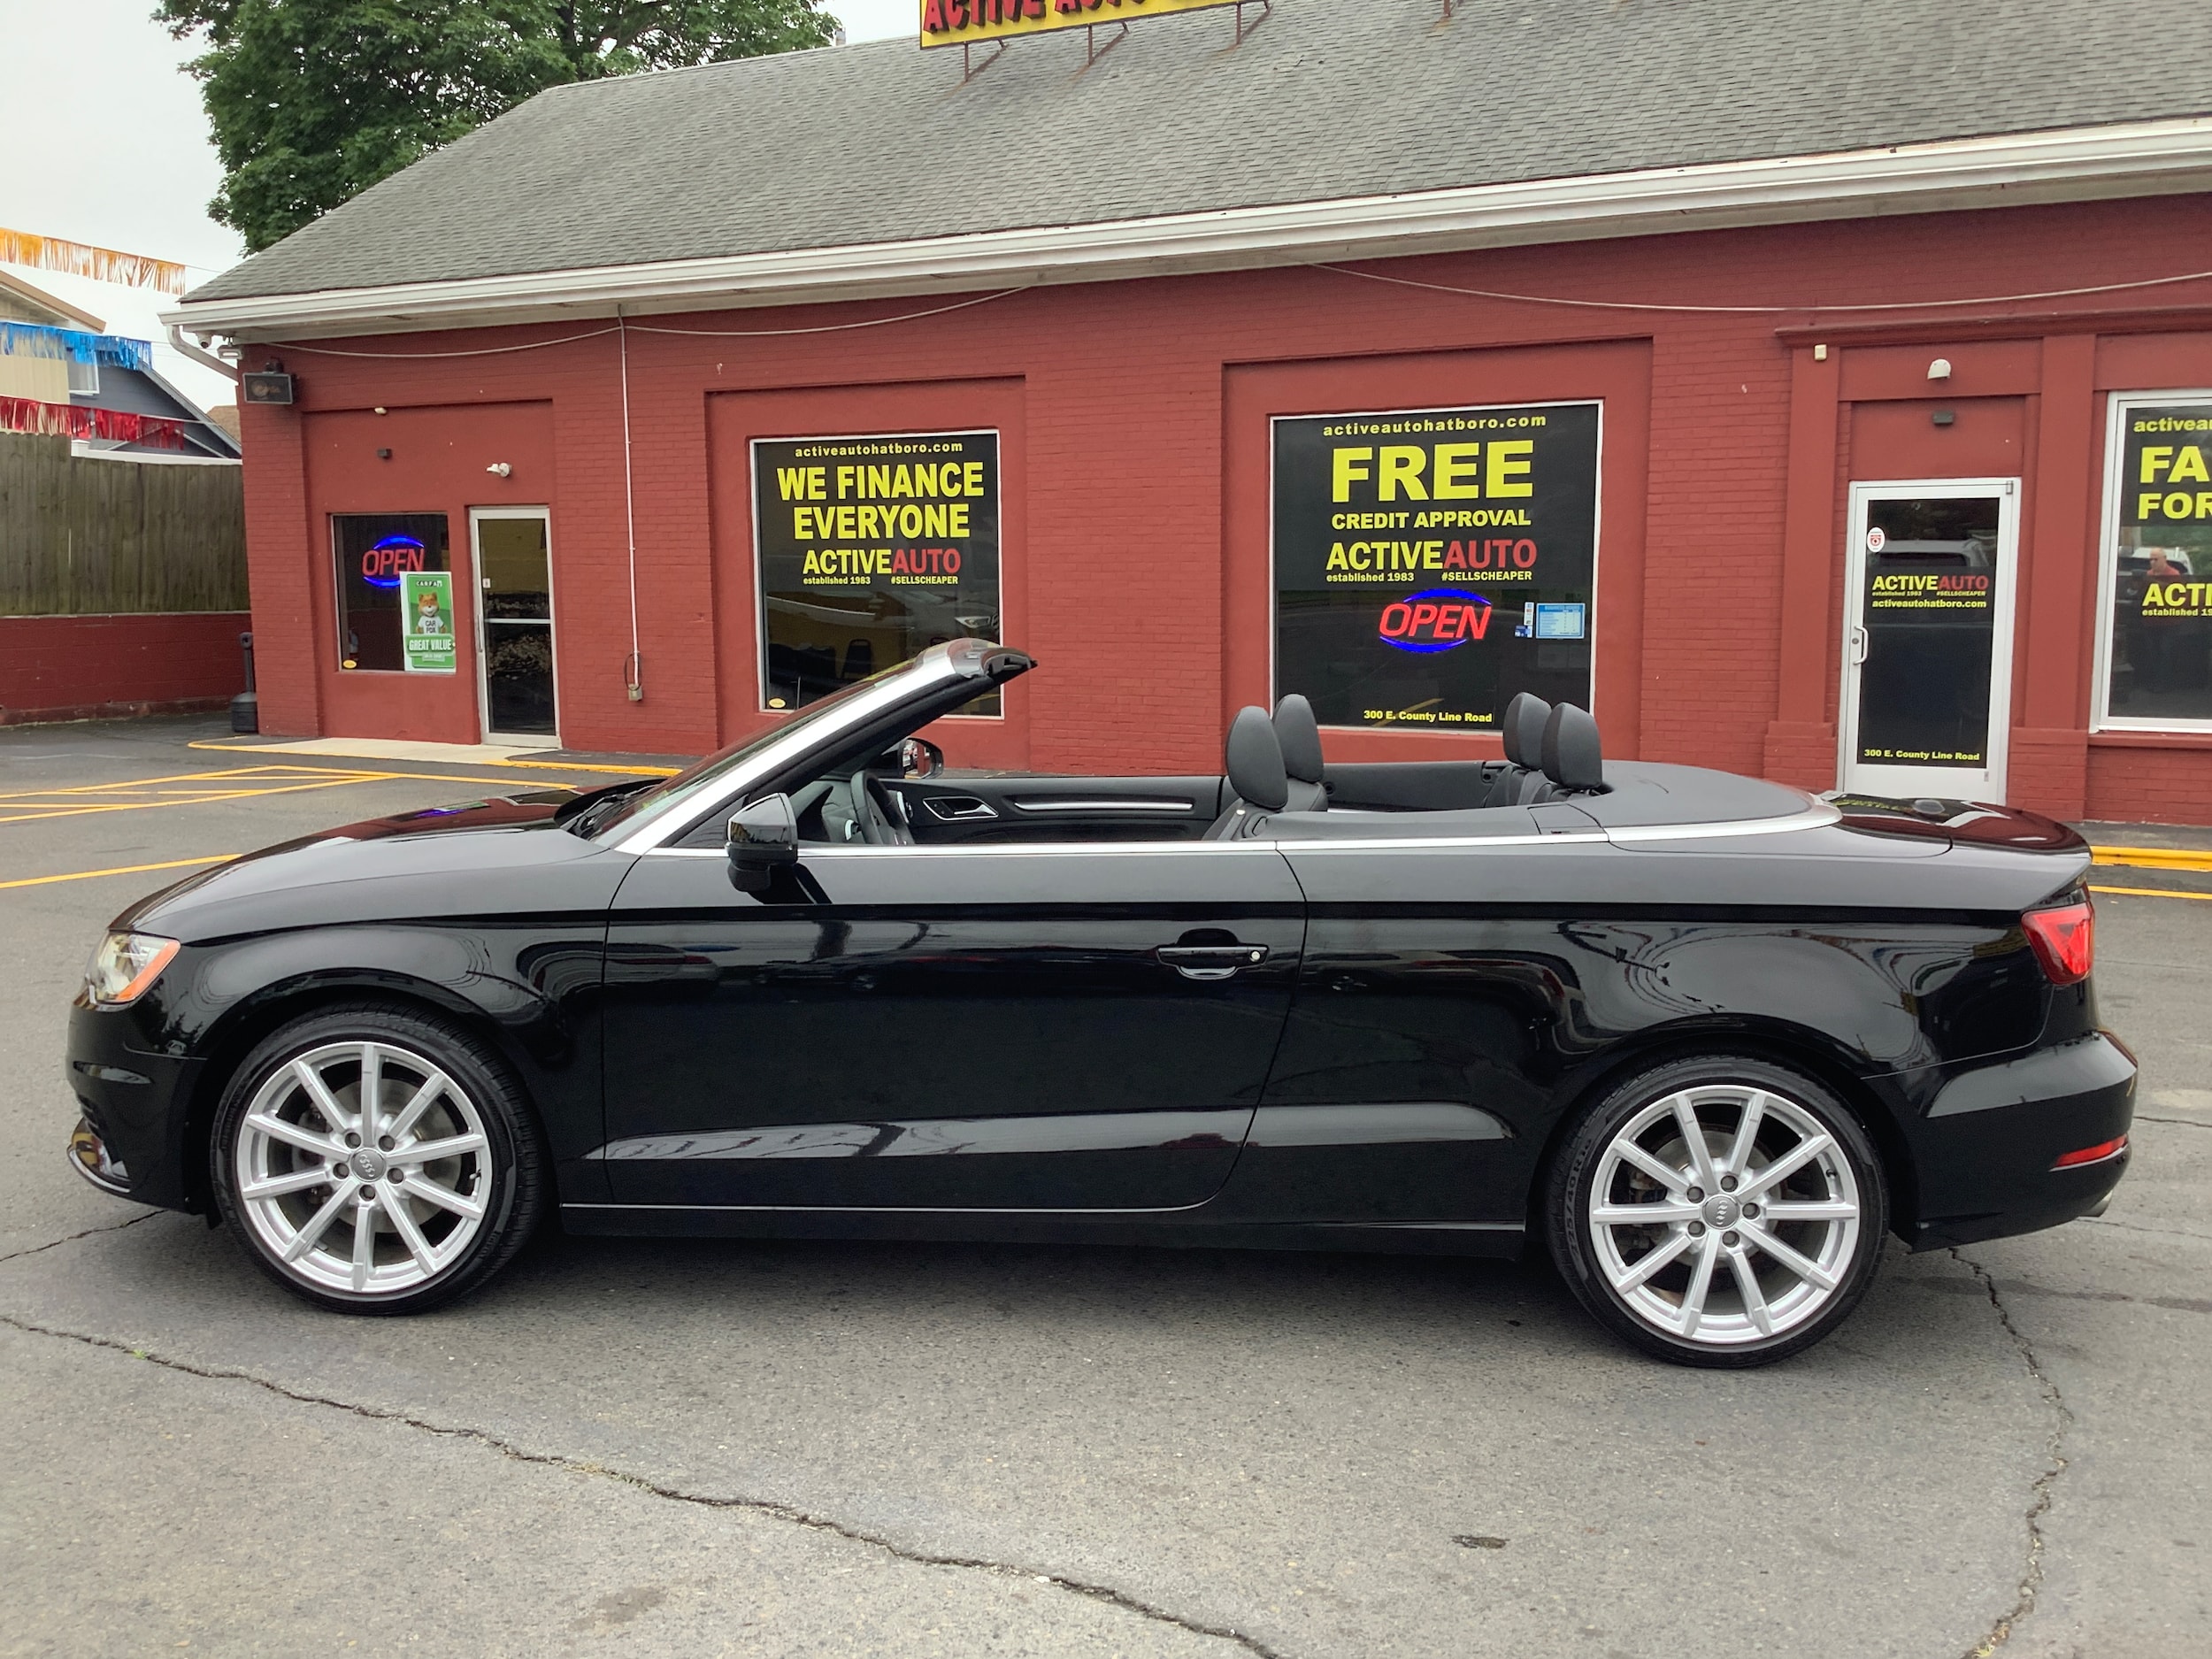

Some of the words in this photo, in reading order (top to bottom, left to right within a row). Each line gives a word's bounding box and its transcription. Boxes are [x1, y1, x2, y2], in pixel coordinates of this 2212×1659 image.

[1323, 415, 1547, 436] activeautohatboro.com
[795, 442, 964, 457] activeautohatboro.com
[1332, 440, 1534, 503] FREE
[776, 466, 827, 501] WE
[836, 461, 985, 500] FINANCE
[793, 503, 971, 540] EVERYONE
[1331, 512, 1409, 530] CREDIT
[1413, 509, 1532, 528] APPROVAL
[362, 549, 425, 576] OPEN
[803, 548, 961, 574] ACTIVEAUTO
[1325, 538, 1538, 571] ACTIVEAUTO
[803, 576, 849, 585] established
[890, 575, 958, 585] #SELLSCHEAPER
[1326, 572, 1385, 582] established
[1386, 572, 1415, 581] 1983
[1441, 571, 1532, 582] #SELLSCHEAPER
[1871, 575, 1989, 591] ACTIVEAUTO
[1871, 598, 1987, 608] activeautohatboro.com
[1379, 603, 1492, 639] OPEN
[2142, 608, 2199, 617] established
[409, 640, 429, 650] GREAT
[431, 640, 451, 650] VALUE
[1363, 710, 1383, 719] 300
[1386, 710, 1396, 720] E.
[1399, 710, 1436, 723] County
[1438, 712, 1462, 722] Line
[1464, 712, 1493, 723] Road
[1864, 749, 1882, 757] 300
[1895, 750, 1930, 760] County
[1932, 751, 1953, 760] Line
[1955, 752, 1980, 761] Road
